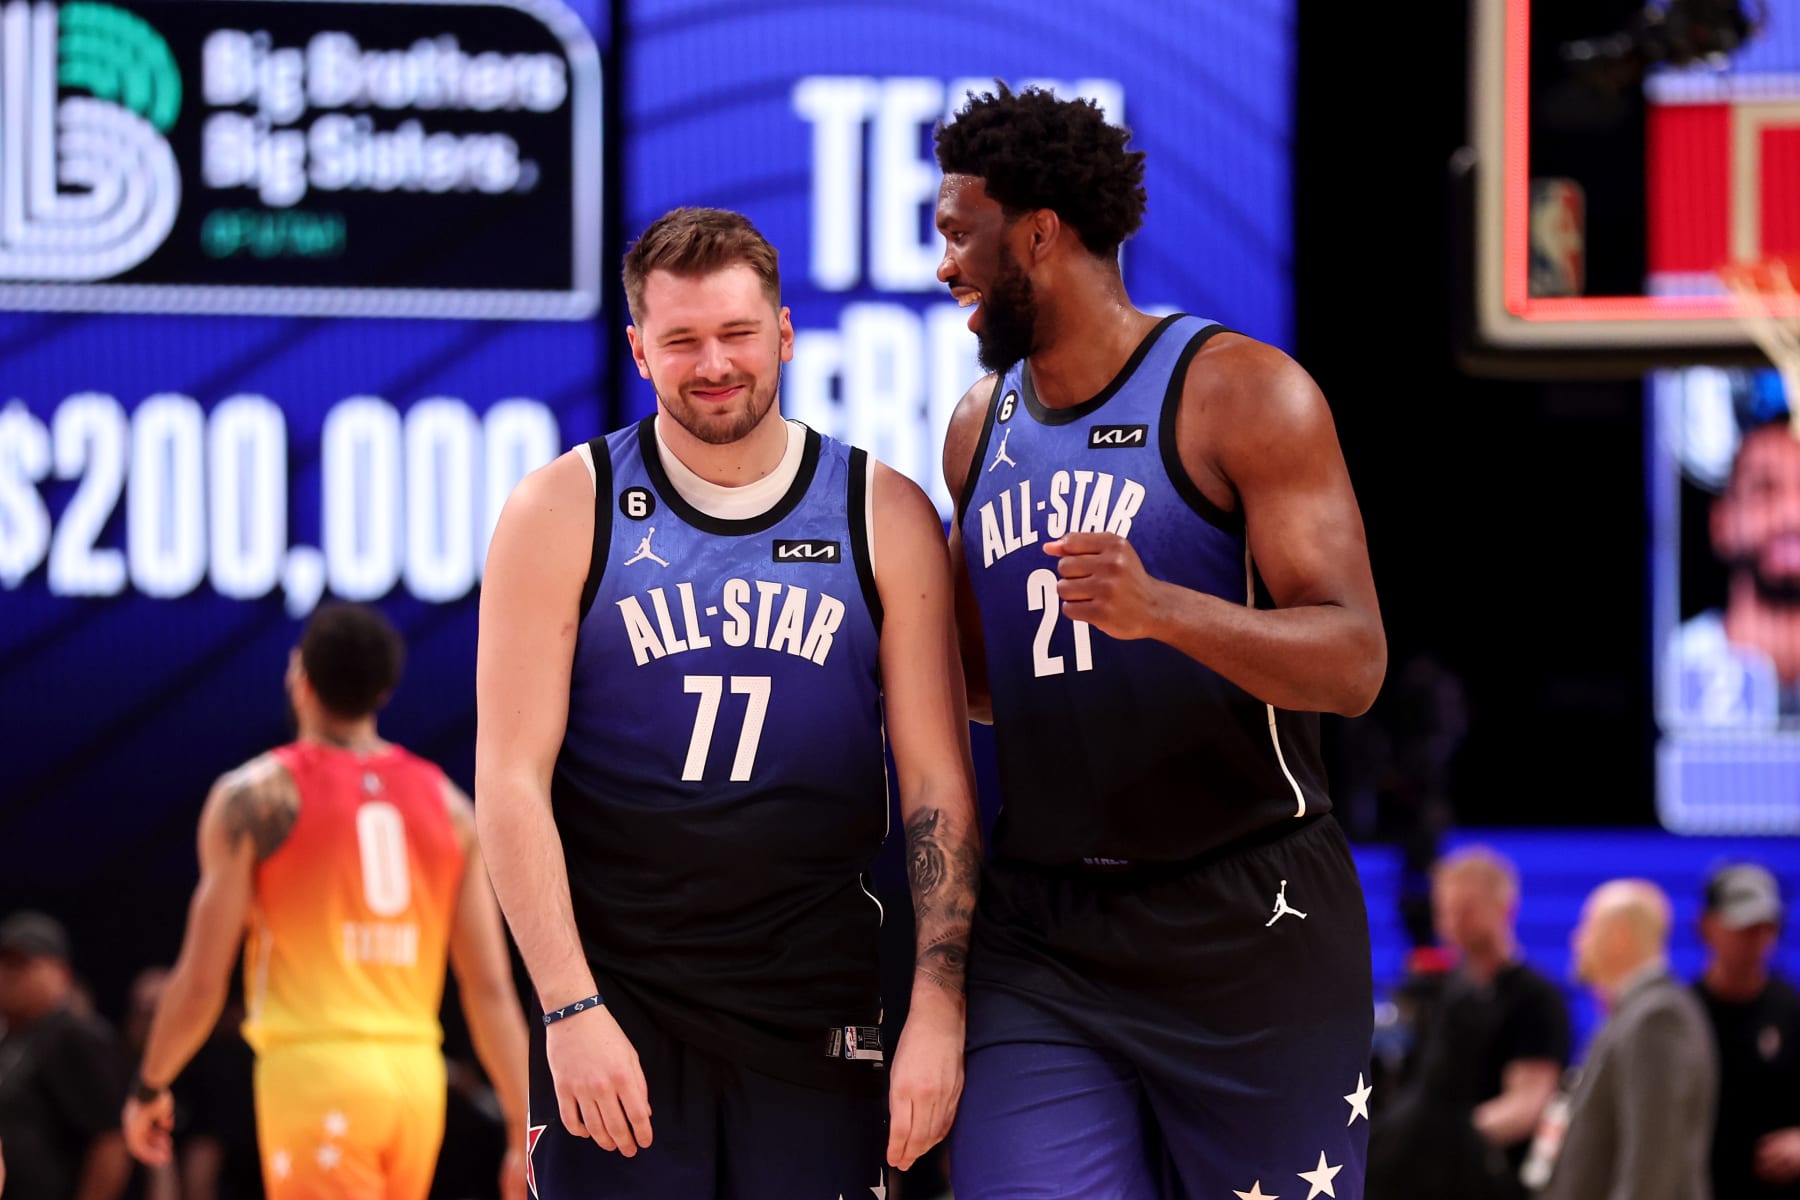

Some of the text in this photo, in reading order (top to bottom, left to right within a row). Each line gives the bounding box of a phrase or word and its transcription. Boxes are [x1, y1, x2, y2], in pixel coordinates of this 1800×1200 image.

[203, 28, 306, 124] Big
[203, 111, 306, 207] Big
[1000, 394, 1016, 421] 6
[1092, 429, 1143, 443] KIA
[627, 492, 647, 516] 6
[979, 470, 1146, 568] ALL-STAR
[778, 544, 835, 559] KIA
[615, 579, 846, 666] ALL-STAR
[681, 675, 771, 782] 77
[356, 801, 412, 917] 0
